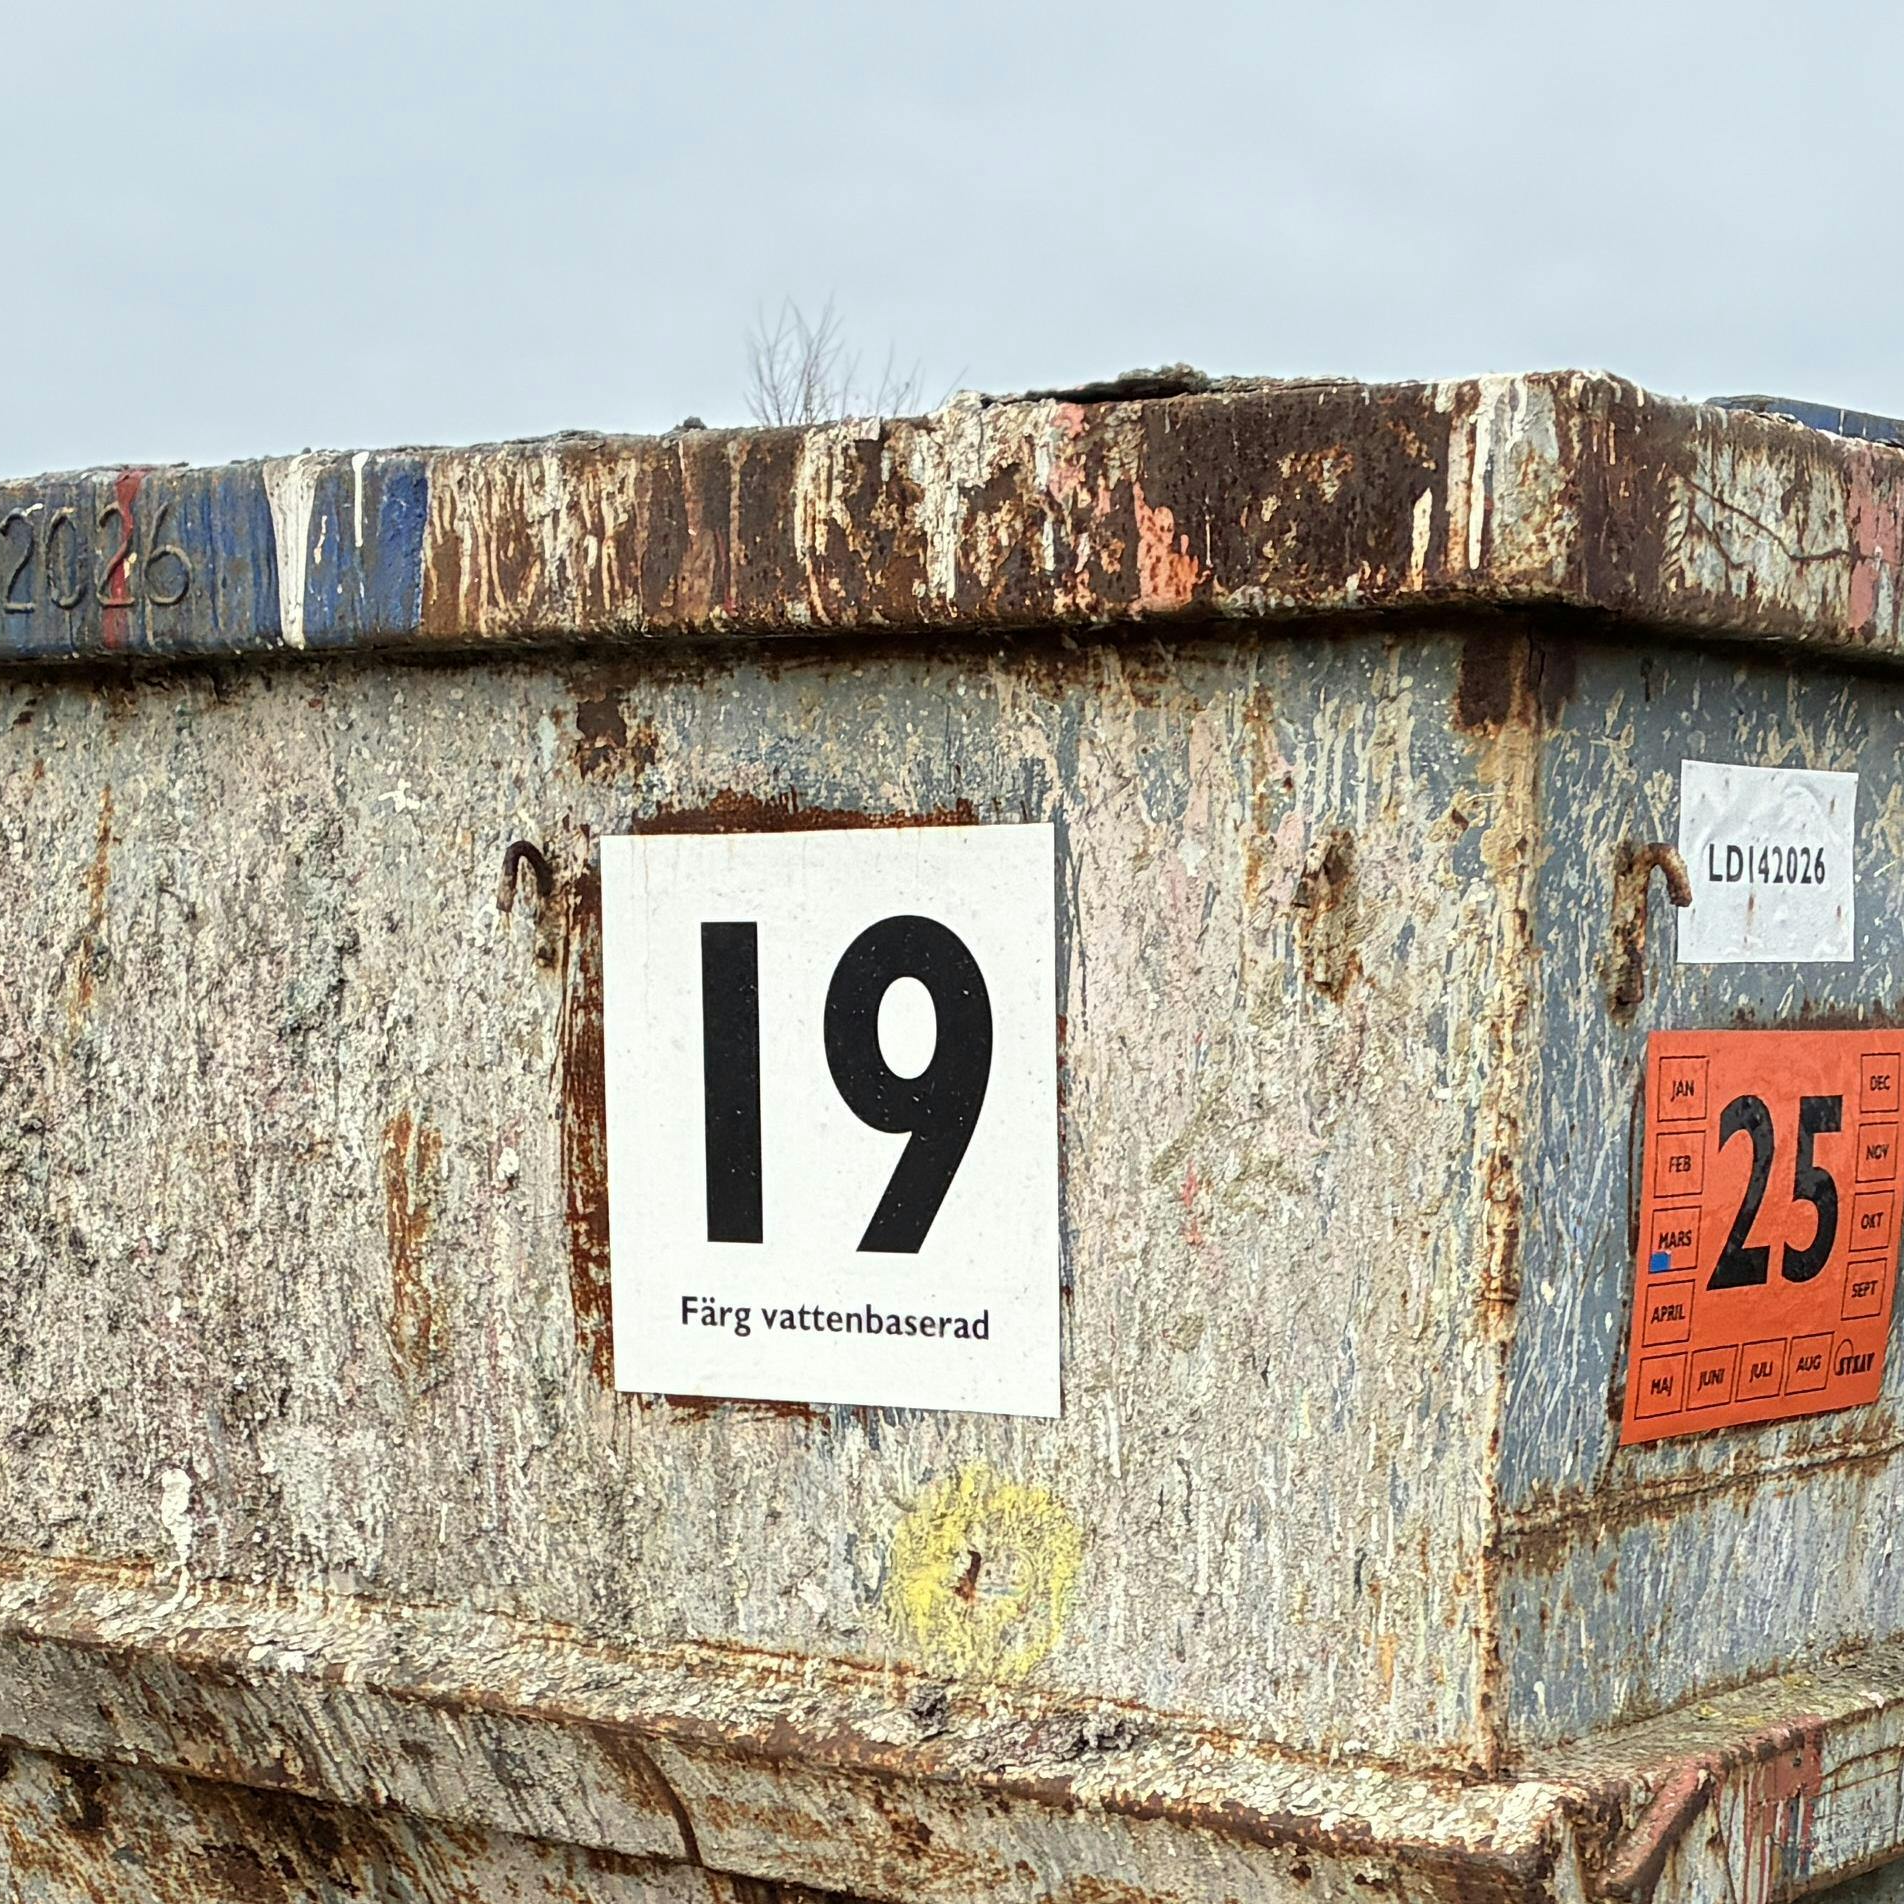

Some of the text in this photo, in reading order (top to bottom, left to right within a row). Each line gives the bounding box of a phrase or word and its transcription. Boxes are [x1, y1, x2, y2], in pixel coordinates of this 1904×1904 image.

[1709, 843, 1825, 885] LD142026
[700, 914, 994, 1255] 19
[1670, 1078, 1695, 1103] JAN
[1870, 1074, 1891, 1092] DEC
[1865, 1143, 1890, 1162] NOV
[1668, 1154, 1692, 1174] FEB
[1707, 1093, 1844, 1292] 25
[1860, 1210, 1885, 1232] OKT
[1658, 1228, 1693, 1249] MARS
[1851, 1279, 1879, 1300] SEPT
[680, 1295, 991, 1341] Färg vattenbaserad
[1650, 1303, 1686, 1325] APRIL
[1749, 1360, 1773, 1383] JULI
[1795, 1353, 1822, 1375] AUG
[1650, 1375, 1674, 1398] MAJ
[1697, 1366, 1726, 1391] JUNI
